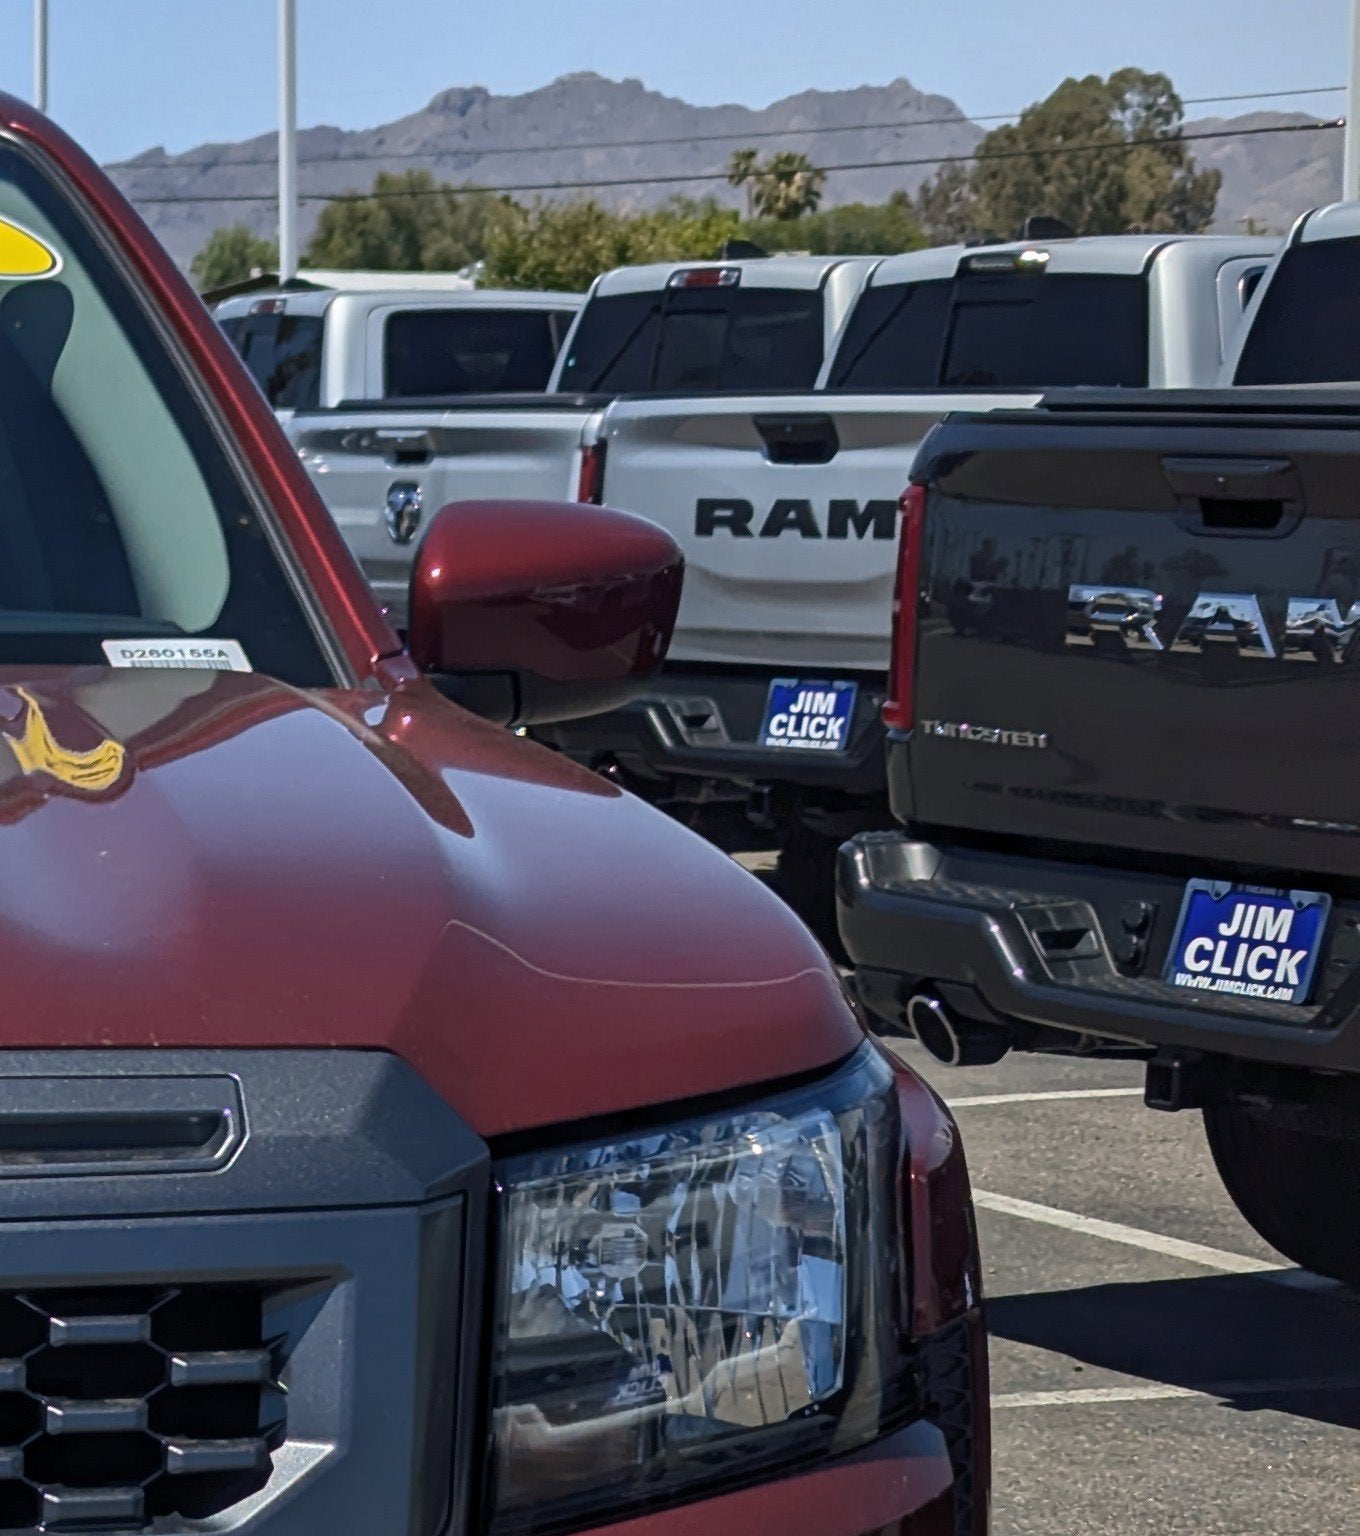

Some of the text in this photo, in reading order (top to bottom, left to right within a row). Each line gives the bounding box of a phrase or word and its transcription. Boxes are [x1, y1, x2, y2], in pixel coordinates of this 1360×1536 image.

[694, 497, 898, 541] RAM
[788, 690, 837, 715] JIM
[768, 712, 846, 740] CLICK
[1217, 903, 1295, 944] JIM
[1183, 936, 1308, 986] CLICK
